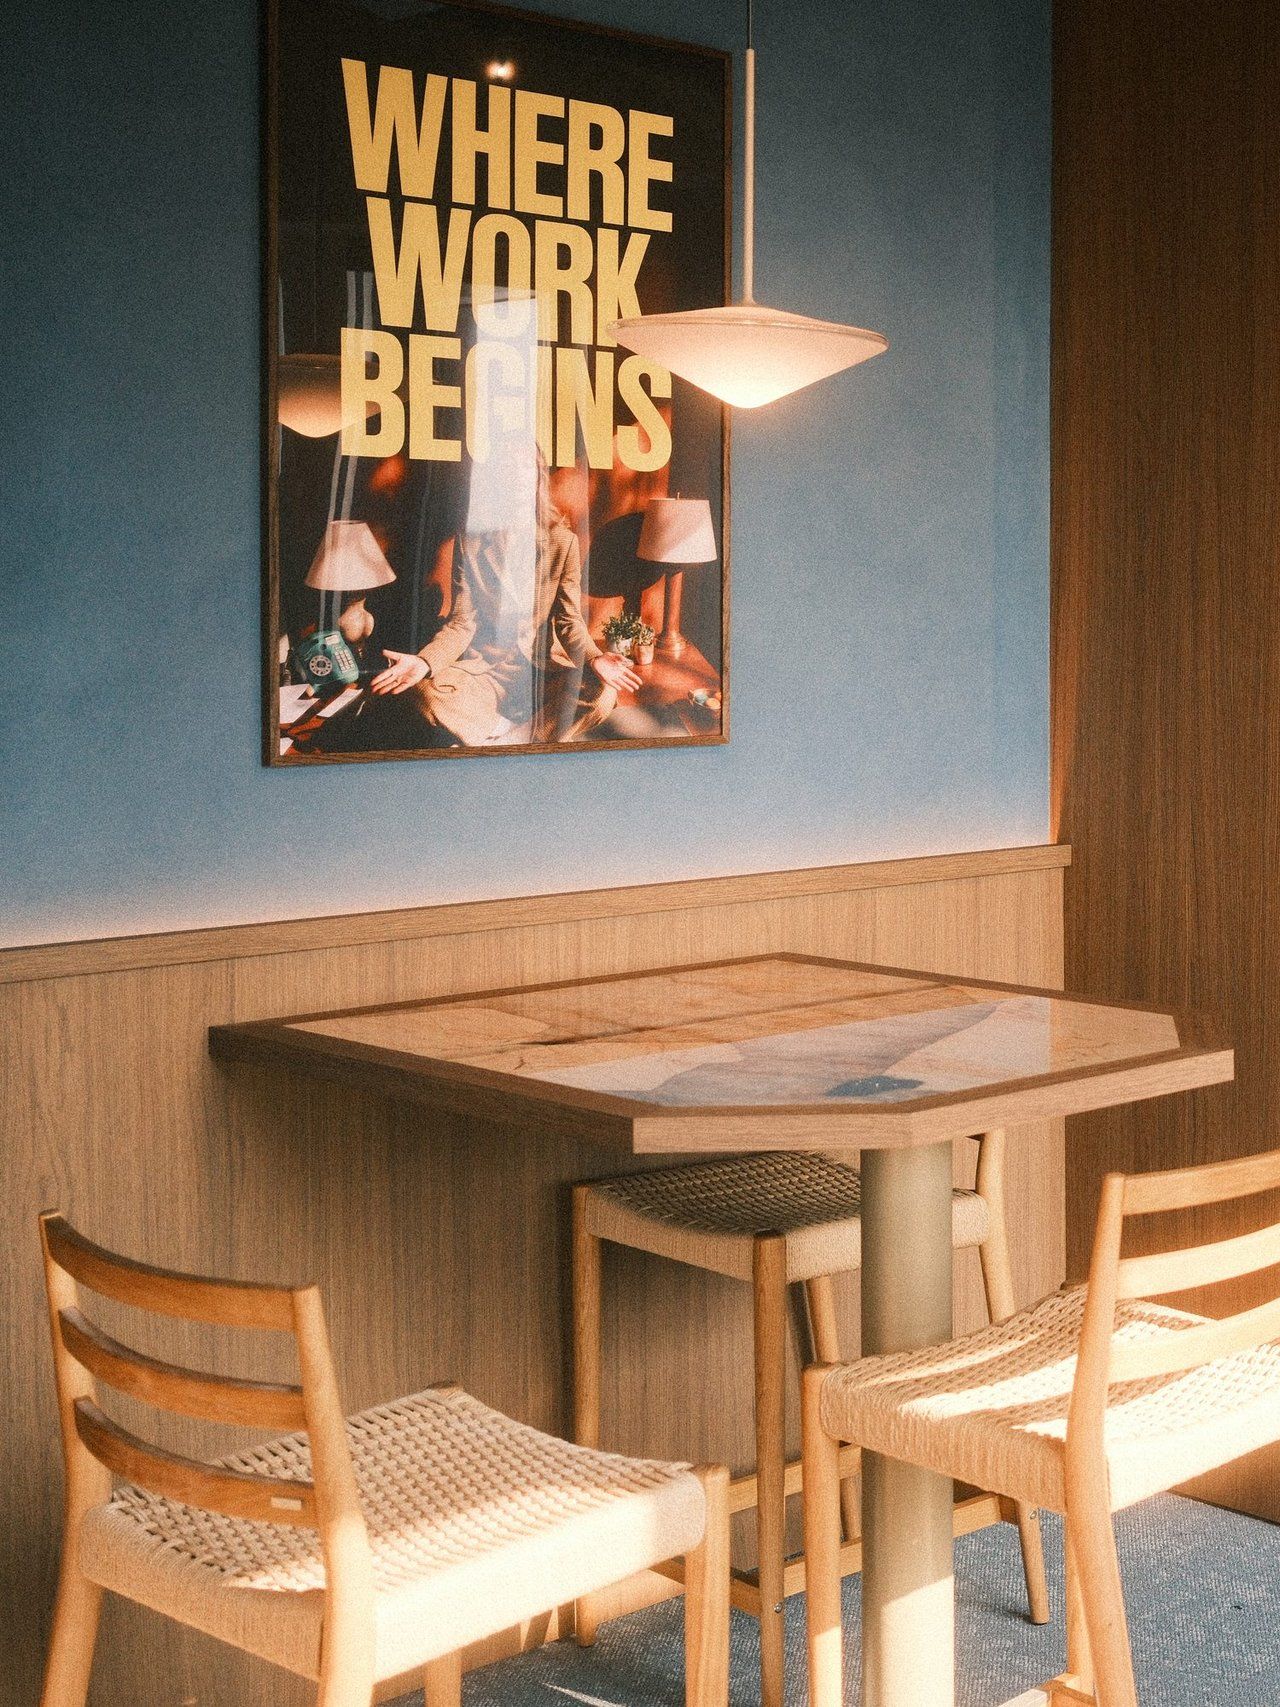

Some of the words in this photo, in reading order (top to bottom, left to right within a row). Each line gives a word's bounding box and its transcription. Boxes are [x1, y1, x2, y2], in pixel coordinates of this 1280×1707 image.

[341, 57, 673, 232] WHERE
[366, 195, 651, 347] WORK
[340, 327, 673, 472] BEGINS
